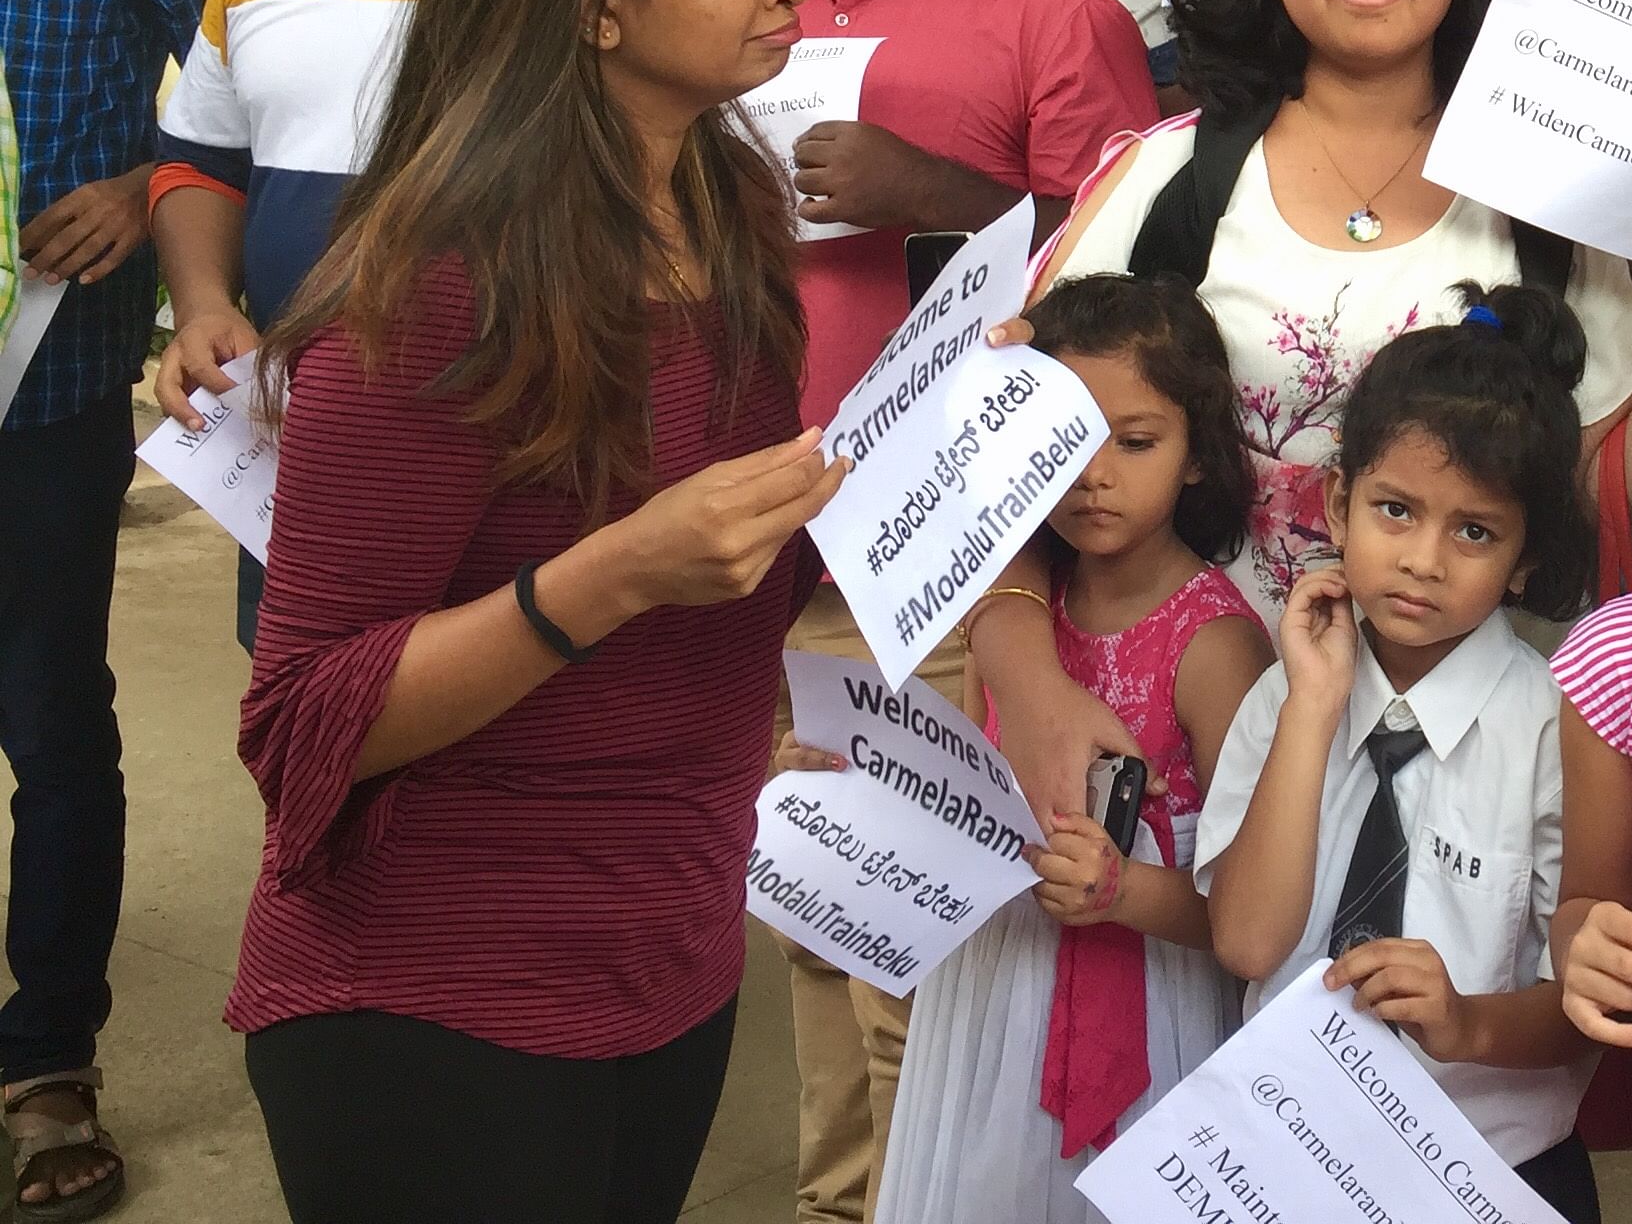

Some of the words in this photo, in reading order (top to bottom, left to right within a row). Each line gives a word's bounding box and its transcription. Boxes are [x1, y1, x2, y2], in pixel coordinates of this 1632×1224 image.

[781, 91, 825, 113] needs
[961, 263, 989, 303] to
[832, 315, 983, 473] CarmelaRam
[895, 413, 1090, 647] #ModaluTrainBeku
[843, 676, 980, 772] Welcome
[984, 751, 1011, 795] to
[850, 734, 1026, 862] CarmelaRam
[1320, 1009, 1419, 1136] Welcome
[1416, 1131, 1443, 1162] to
